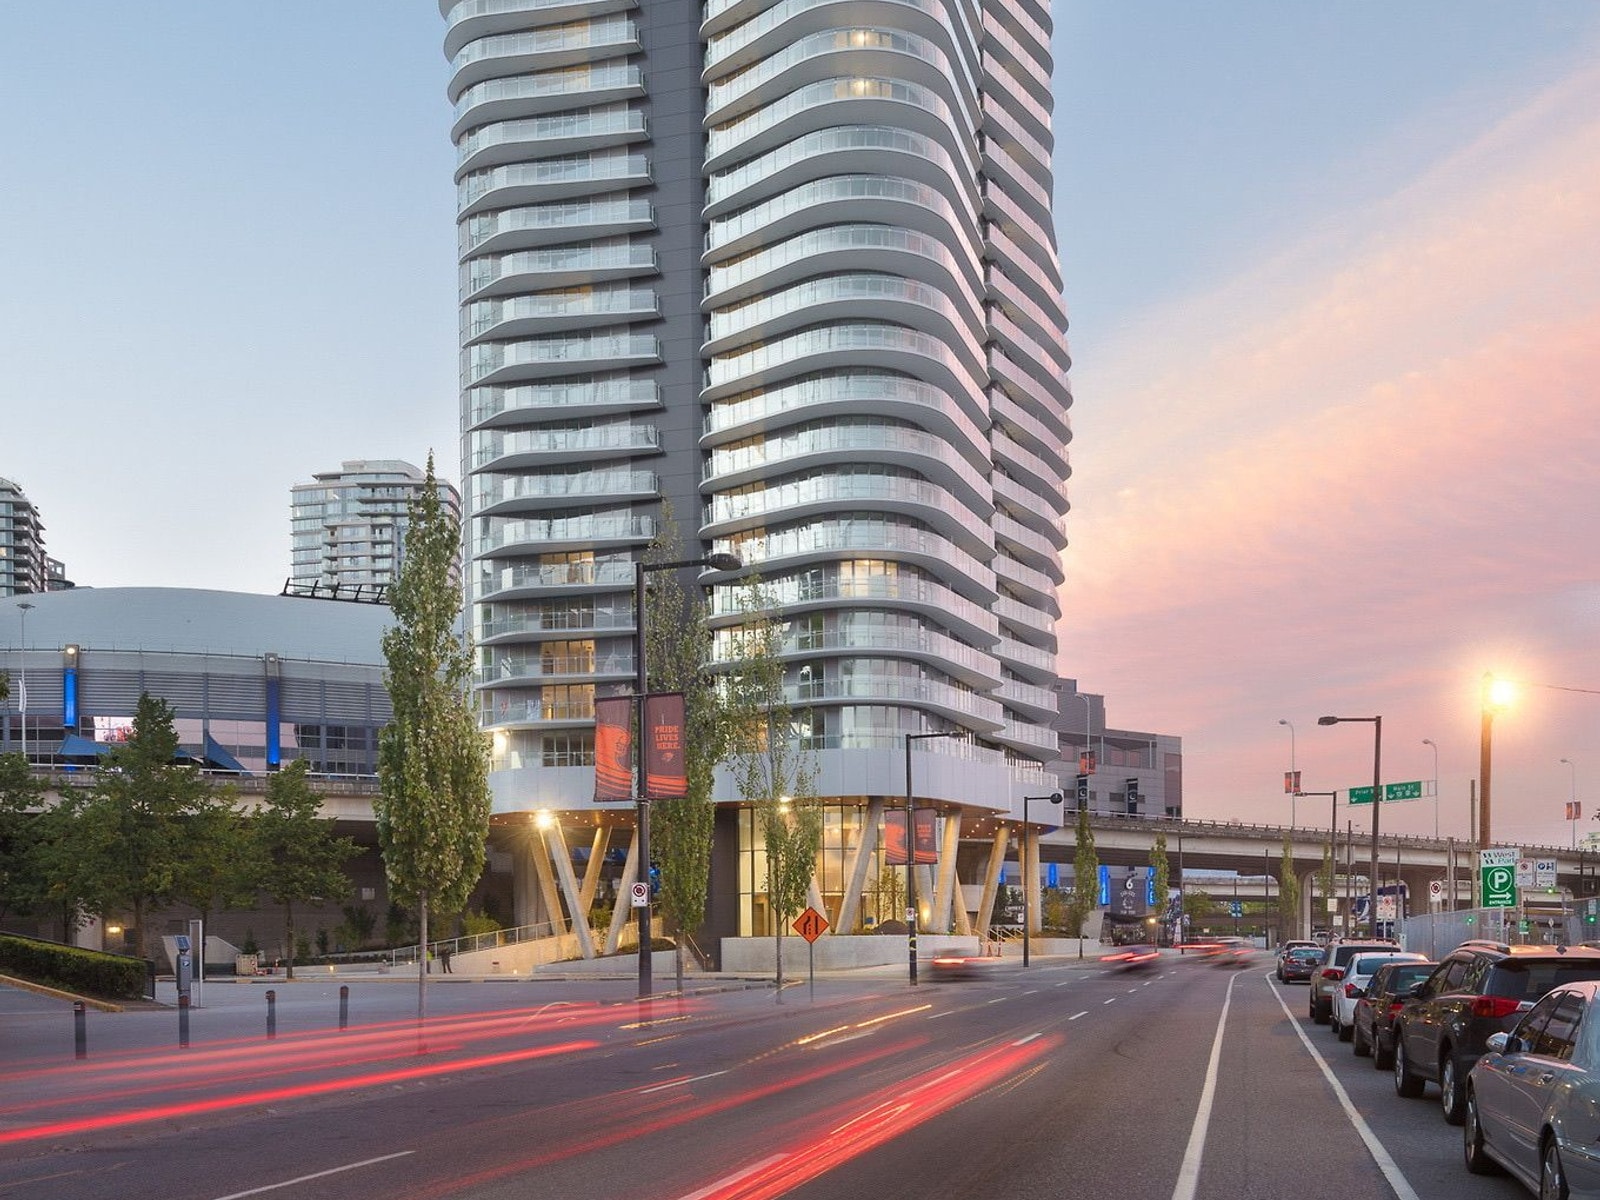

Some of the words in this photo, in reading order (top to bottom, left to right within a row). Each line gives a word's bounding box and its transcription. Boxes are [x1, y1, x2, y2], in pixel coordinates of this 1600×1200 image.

[655, 725, 679, 734] PRIDE
[655, 733, 679, 741] LIVES
[1126, 878, 1133, 889] 6
[1494, 871, 1508, 889] P
